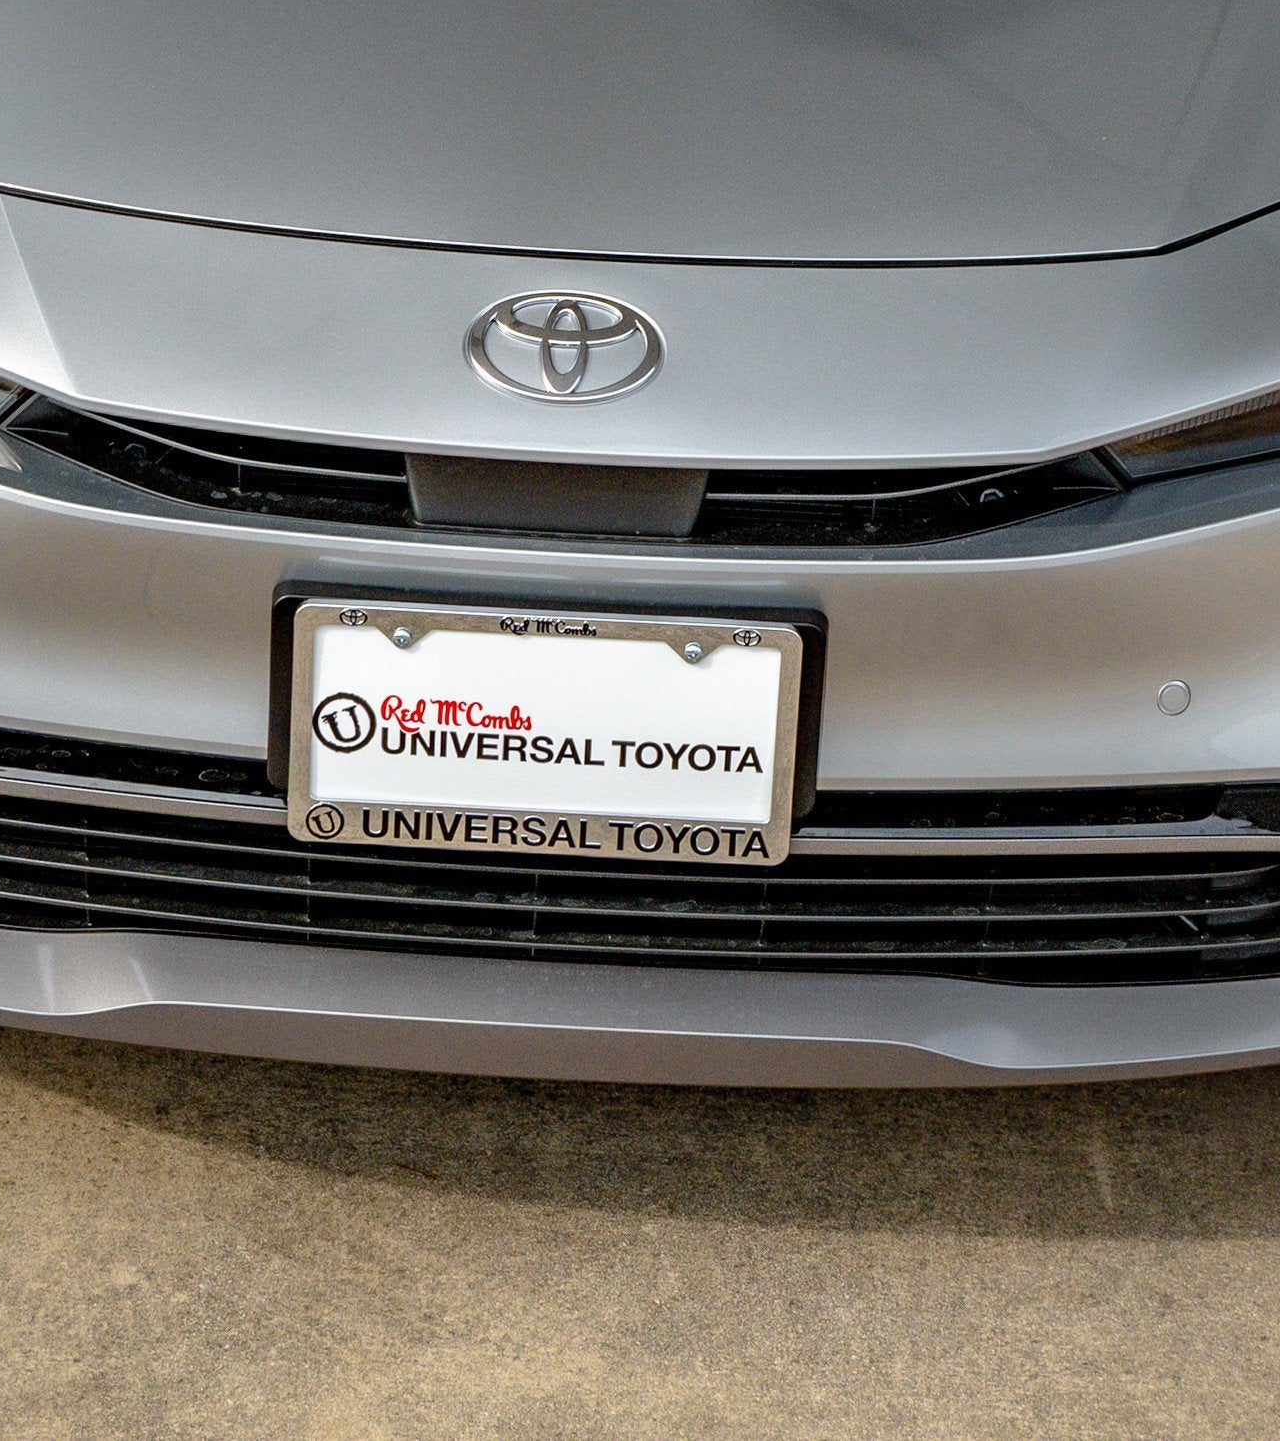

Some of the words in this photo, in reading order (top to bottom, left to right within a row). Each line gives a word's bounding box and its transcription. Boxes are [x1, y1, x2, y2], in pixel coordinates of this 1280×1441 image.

[500, 616, 530, 635] Red
[531, 618, 597, 636] McCombs
[381, 695, 426, 733] Red
[430, 698, 533, 731] McCombs
[380, 726, 605, 766] UNIVERSAL
[611, 740, 764, 774] TOYOTA
[361, 807, 602, 850] UNIVERSAL
[608, 819, 770, 859] TOYOTA
